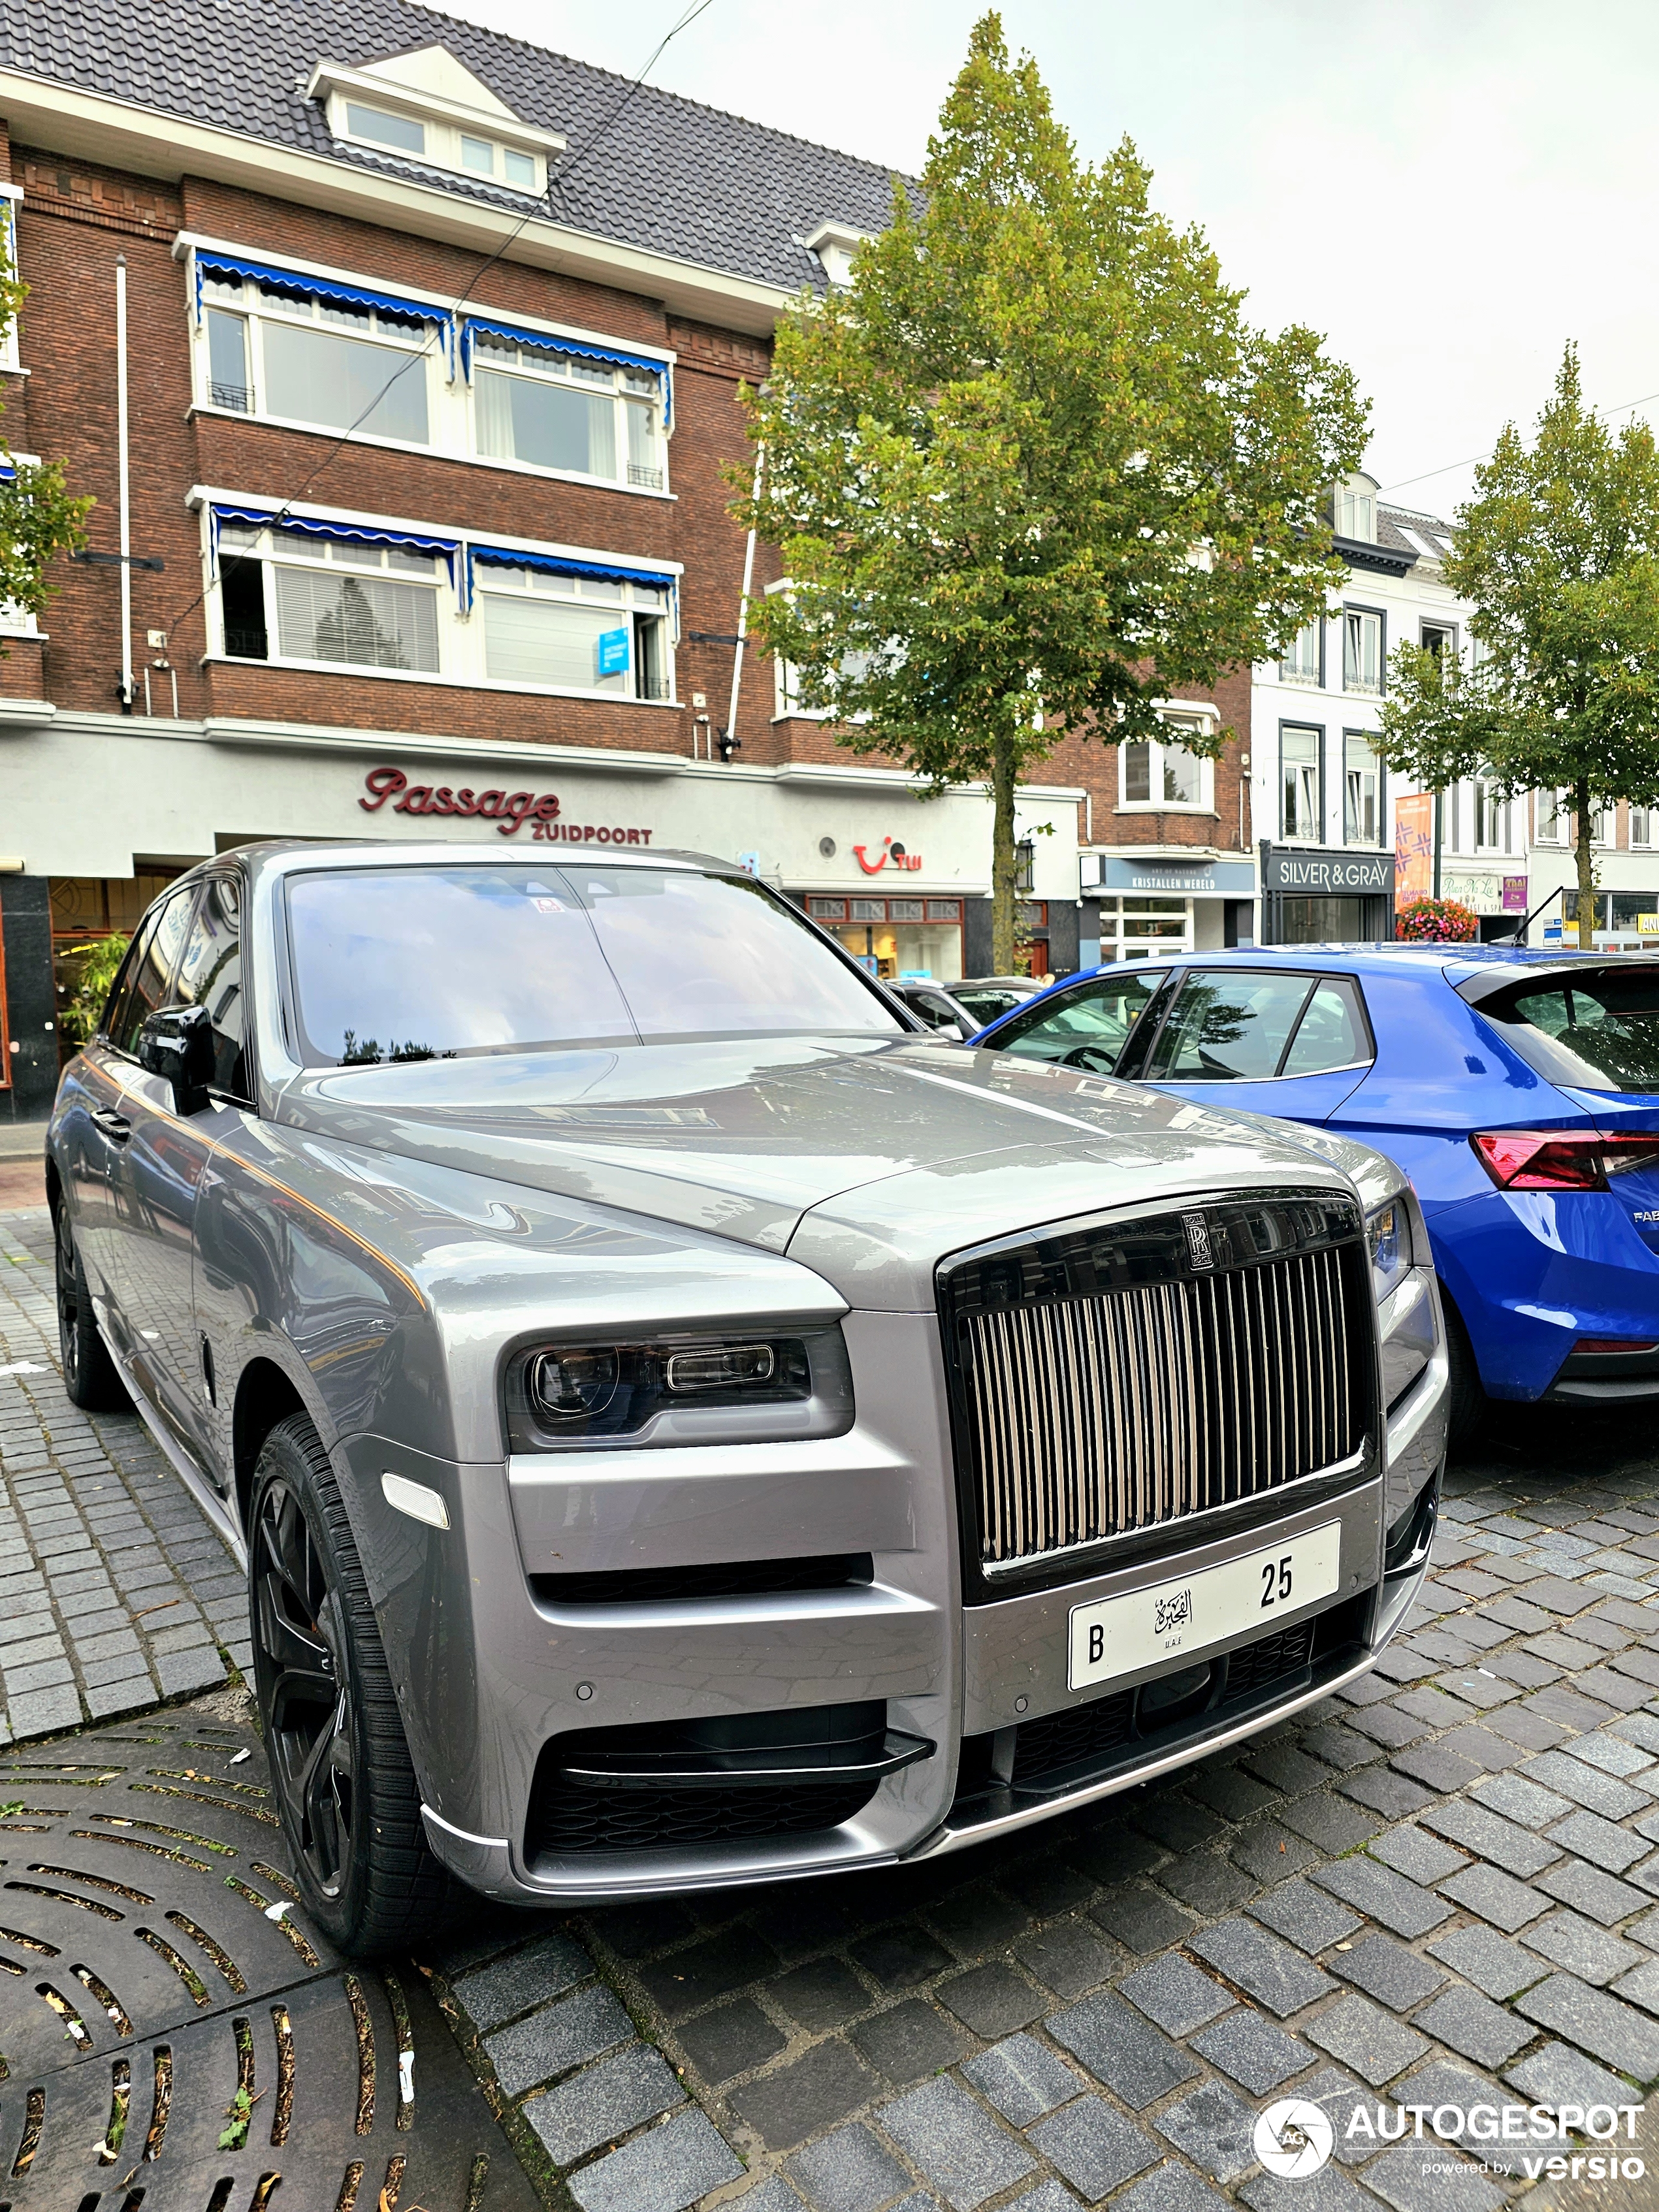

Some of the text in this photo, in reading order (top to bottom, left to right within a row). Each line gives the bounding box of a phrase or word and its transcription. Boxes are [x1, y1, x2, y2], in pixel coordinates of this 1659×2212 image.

[358, 768, 561, 835] Passage
[531, 822, 652, 845] ZUIDPOORT
[895, 853, 922, 871] TUI
[1132, 877, 1216, 890] KRISTALLEN WERELD
[1280, 858, 1388, 892] SILVER & GRAY
[1148, 923, 1158, 934] 21
[1641, 917, 1659, 932] AN
[1185, 1215, 1204, 1225] ROLLS
[1193, 1255, 1211, 1264] ROYCE
[1261, 1555, 1293, 1608] 25
[1155, 1588, 1193, 1634] الفجيرة
[1089, 1624, 1104, 1664] B
